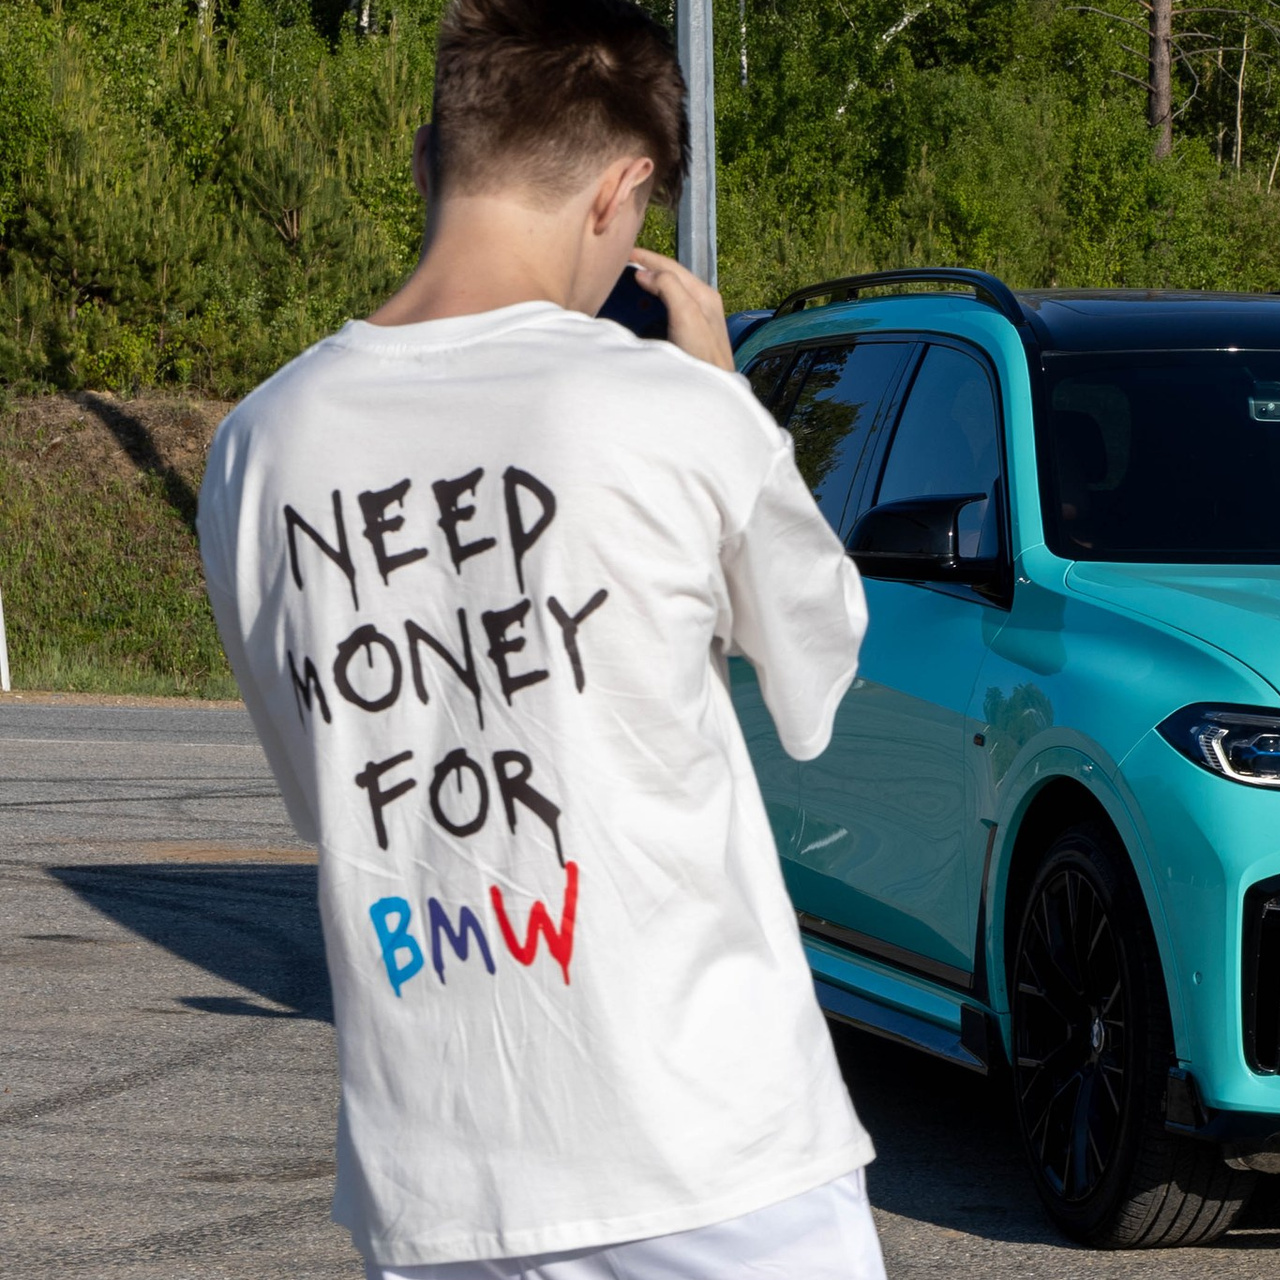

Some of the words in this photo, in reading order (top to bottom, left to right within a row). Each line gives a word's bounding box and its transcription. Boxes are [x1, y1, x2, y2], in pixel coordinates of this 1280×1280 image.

[283, 465, 556, 611] NEED
[287, 589, 608, 731] MONEY
[355, 747, 562, 868] FOR
[369, 861, 578, 997] BMW
